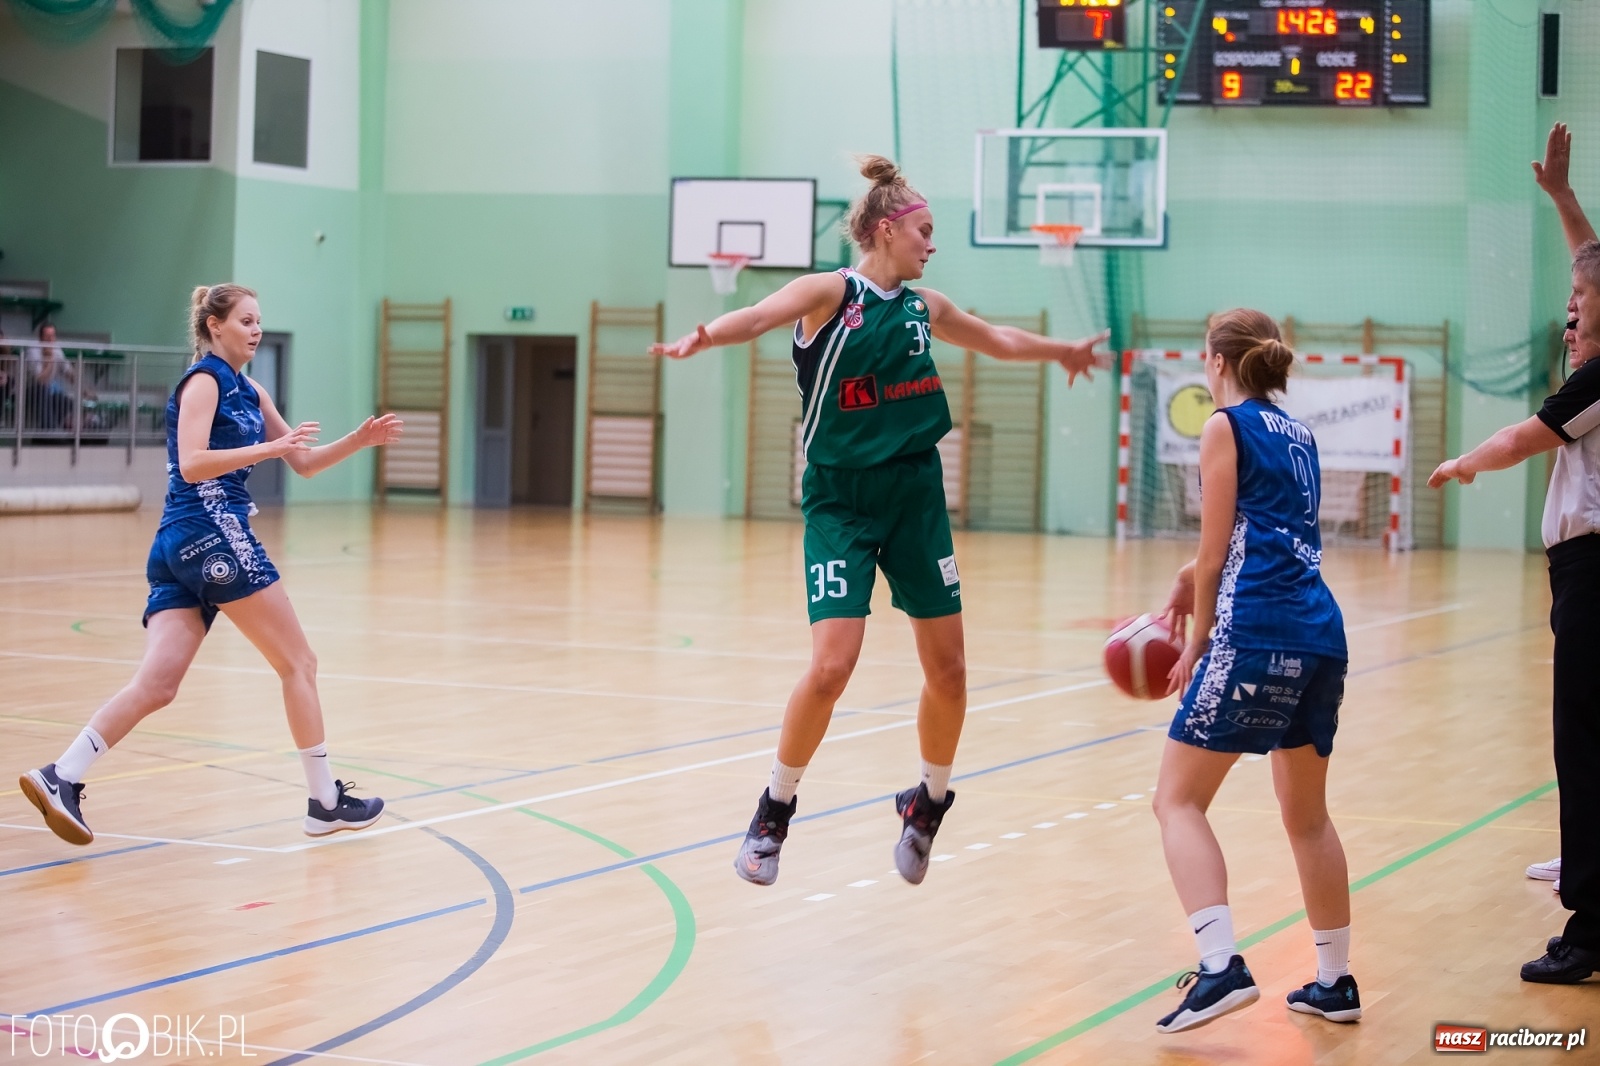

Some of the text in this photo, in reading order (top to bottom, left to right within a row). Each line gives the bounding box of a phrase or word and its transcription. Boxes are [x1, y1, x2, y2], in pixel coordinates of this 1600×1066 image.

[1222, 71, 1241, 99] 9
[1335, 71, 1373, 99] 22
[1288, 443, 1317, 527] 9
[810, 559, 848, 603] 35
